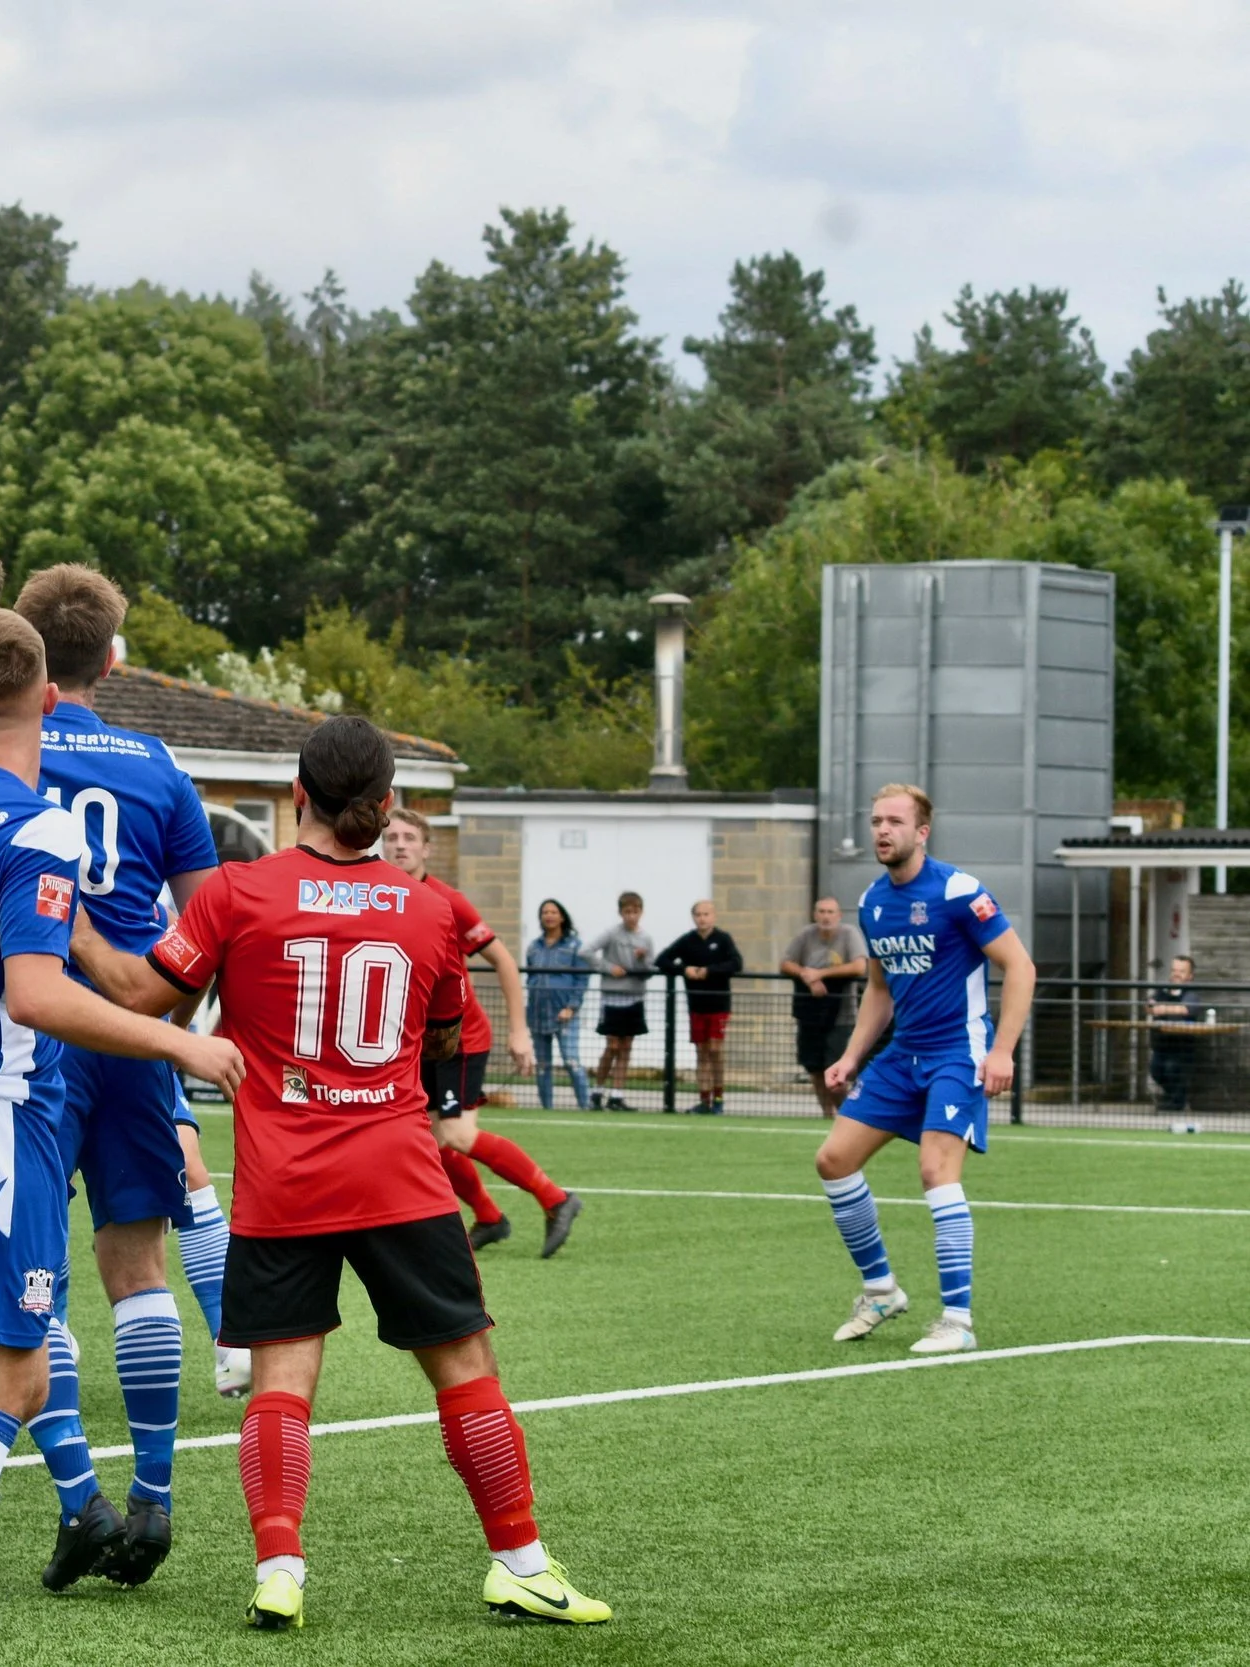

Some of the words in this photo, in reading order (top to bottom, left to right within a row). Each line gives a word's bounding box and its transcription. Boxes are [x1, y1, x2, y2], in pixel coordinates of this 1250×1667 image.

[40, 730, 60, 742] S3
[65, 733, 146, 750] SERVICES
[76, 744, 109, 752] Electrical
[110, 745, 151, 758] Engineering
[869, 934, 936, 956] ROMAN
[880, 955, 933, 974] GLASS
[283, 937, 414, 1067] 10
